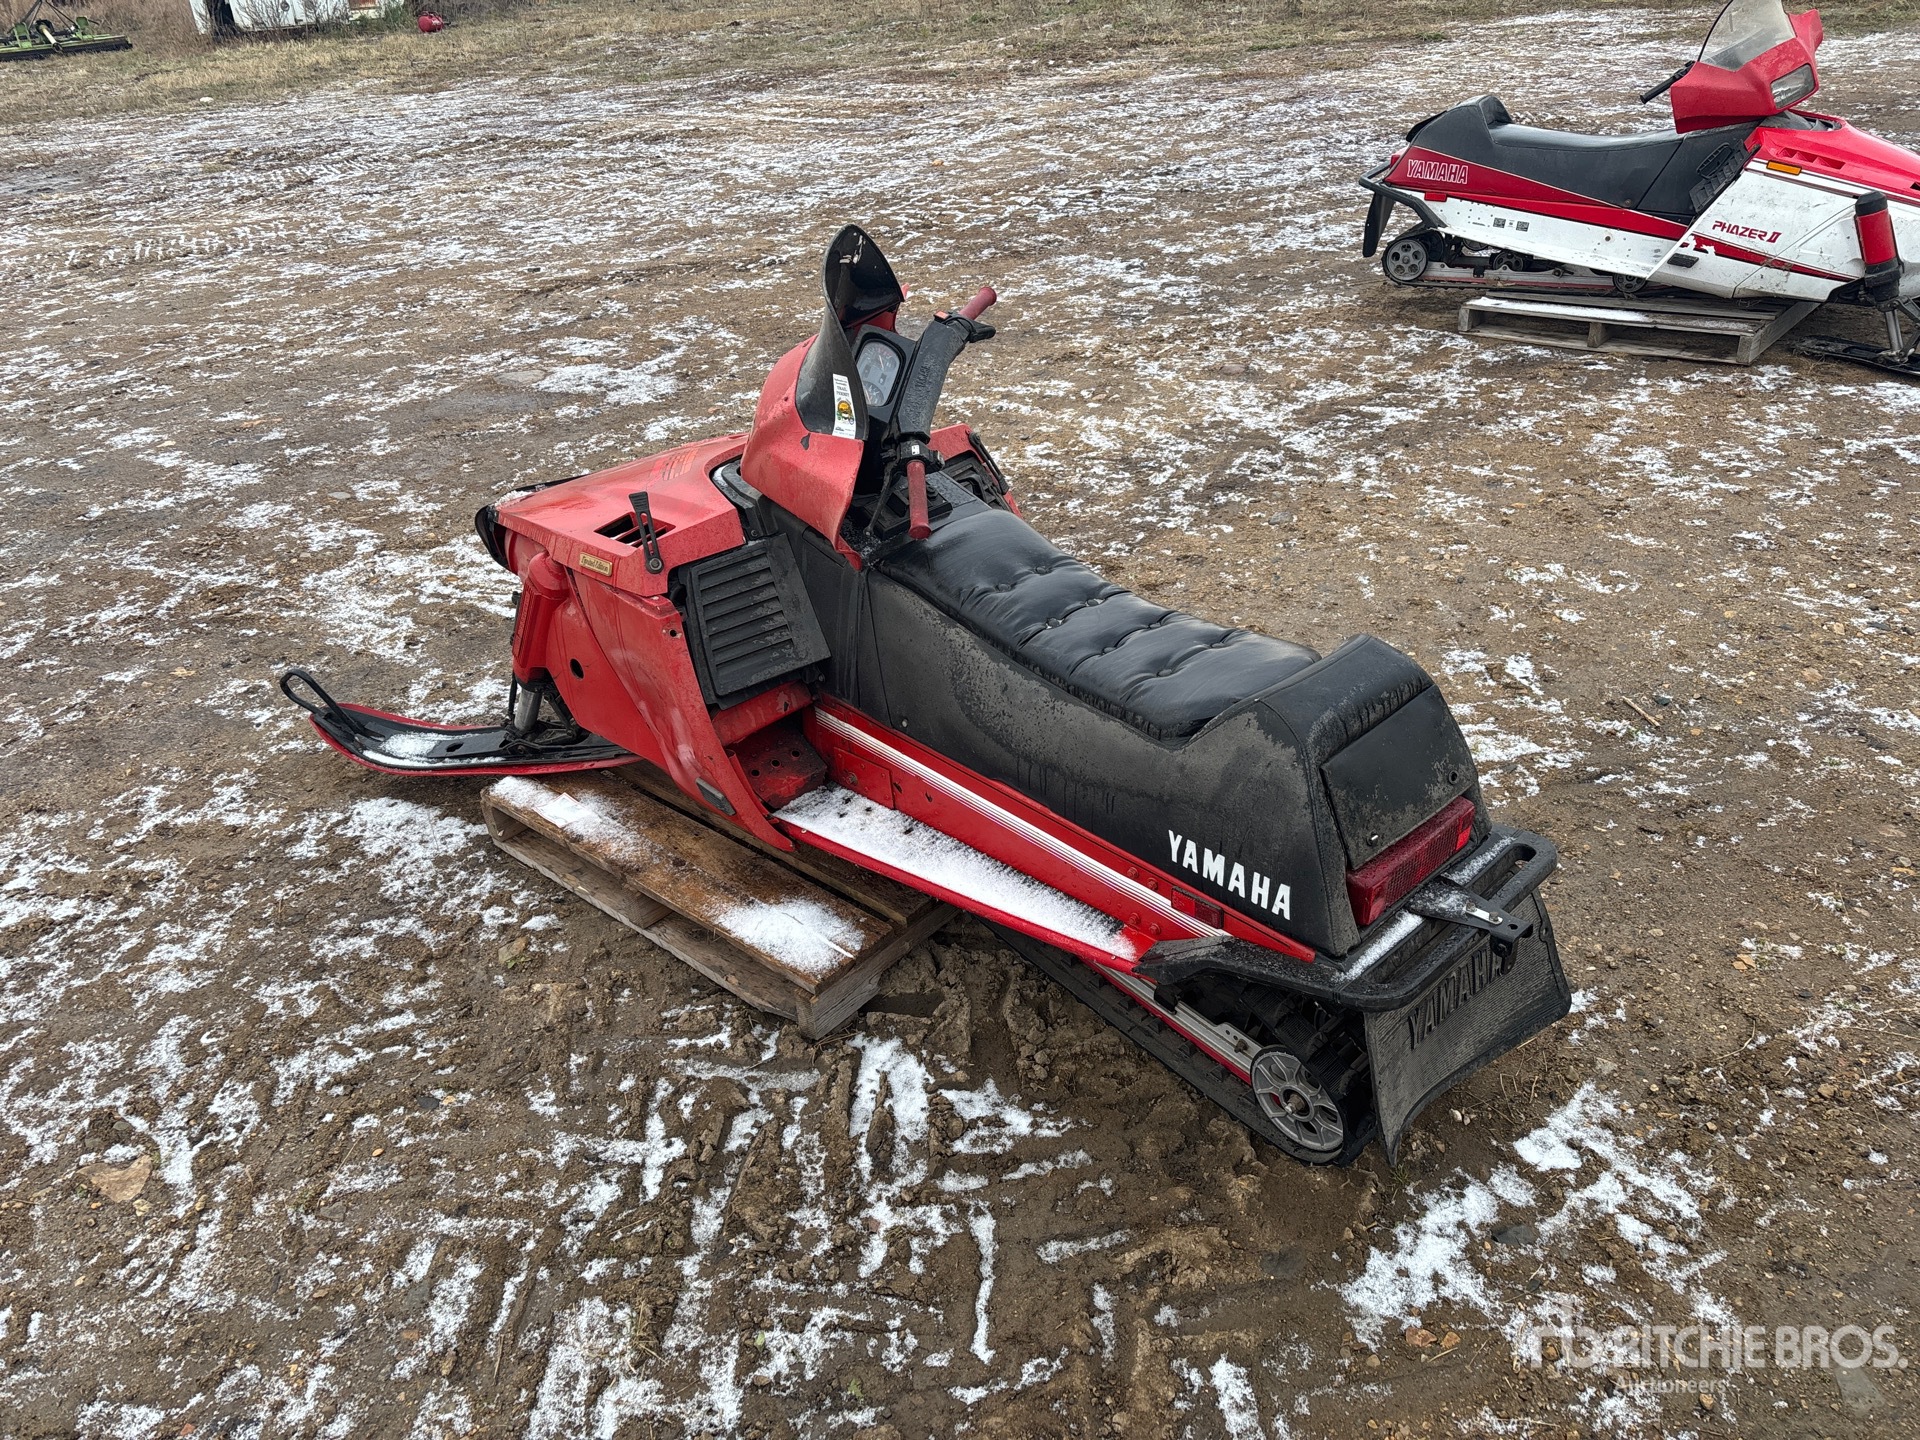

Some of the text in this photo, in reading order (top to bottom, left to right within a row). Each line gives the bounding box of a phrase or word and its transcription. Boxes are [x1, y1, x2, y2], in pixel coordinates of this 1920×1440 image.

[1407, 159, 1468, 185] YAMAHA
[1711, 220, 1768, 241] PHAZER
[1168, 829, 1291, 921] YAMAHA
